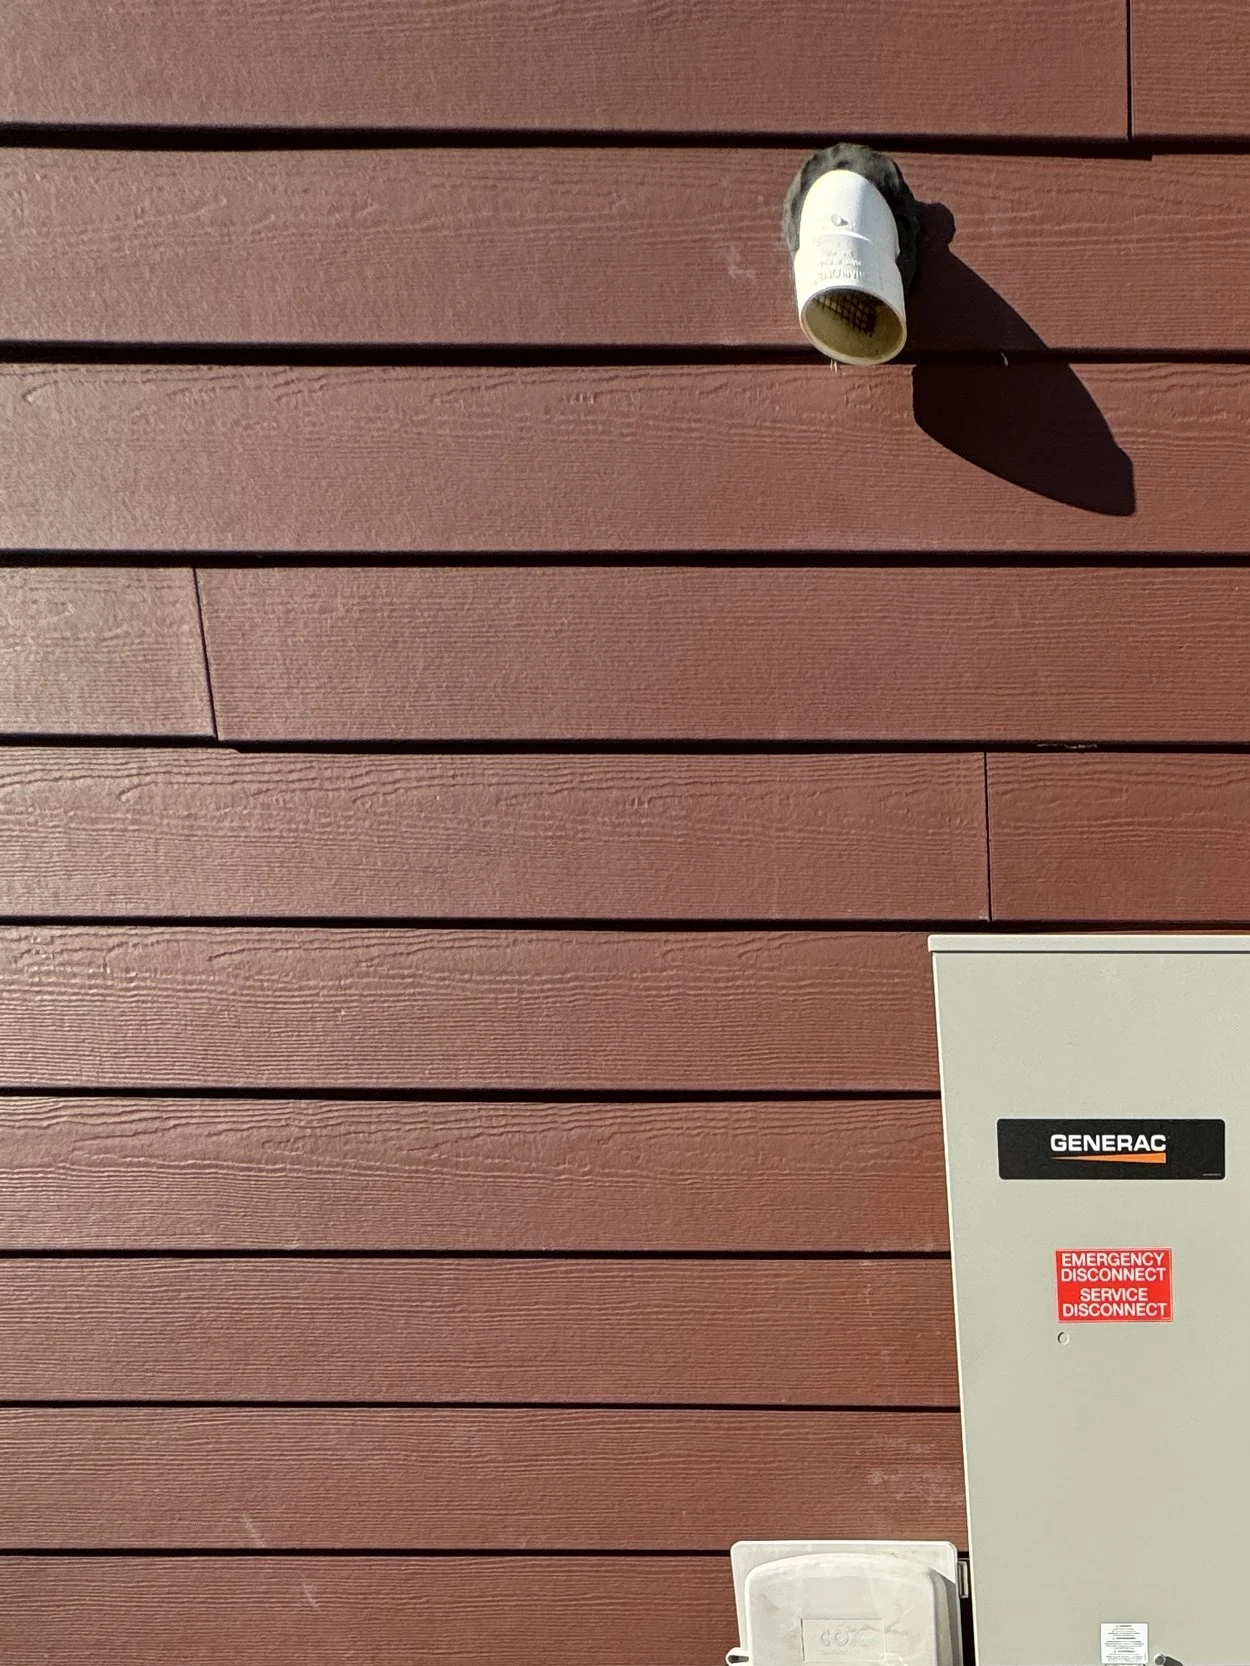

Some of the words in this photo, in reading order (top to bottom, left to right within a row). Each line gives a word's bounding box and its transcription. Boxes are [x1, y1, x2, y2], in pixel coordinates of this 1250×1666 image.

[1050, 1134, 1166, 1152] GENERAC
[1061, 1251, 1165, 1267] EMERGENCY
[1060, 1267, 1167, 1282] DISCONNECT
[1079, 1287, 1149, 1302] SERVICE
[1062, 1302, 1168, 1317] DISCONNECT
